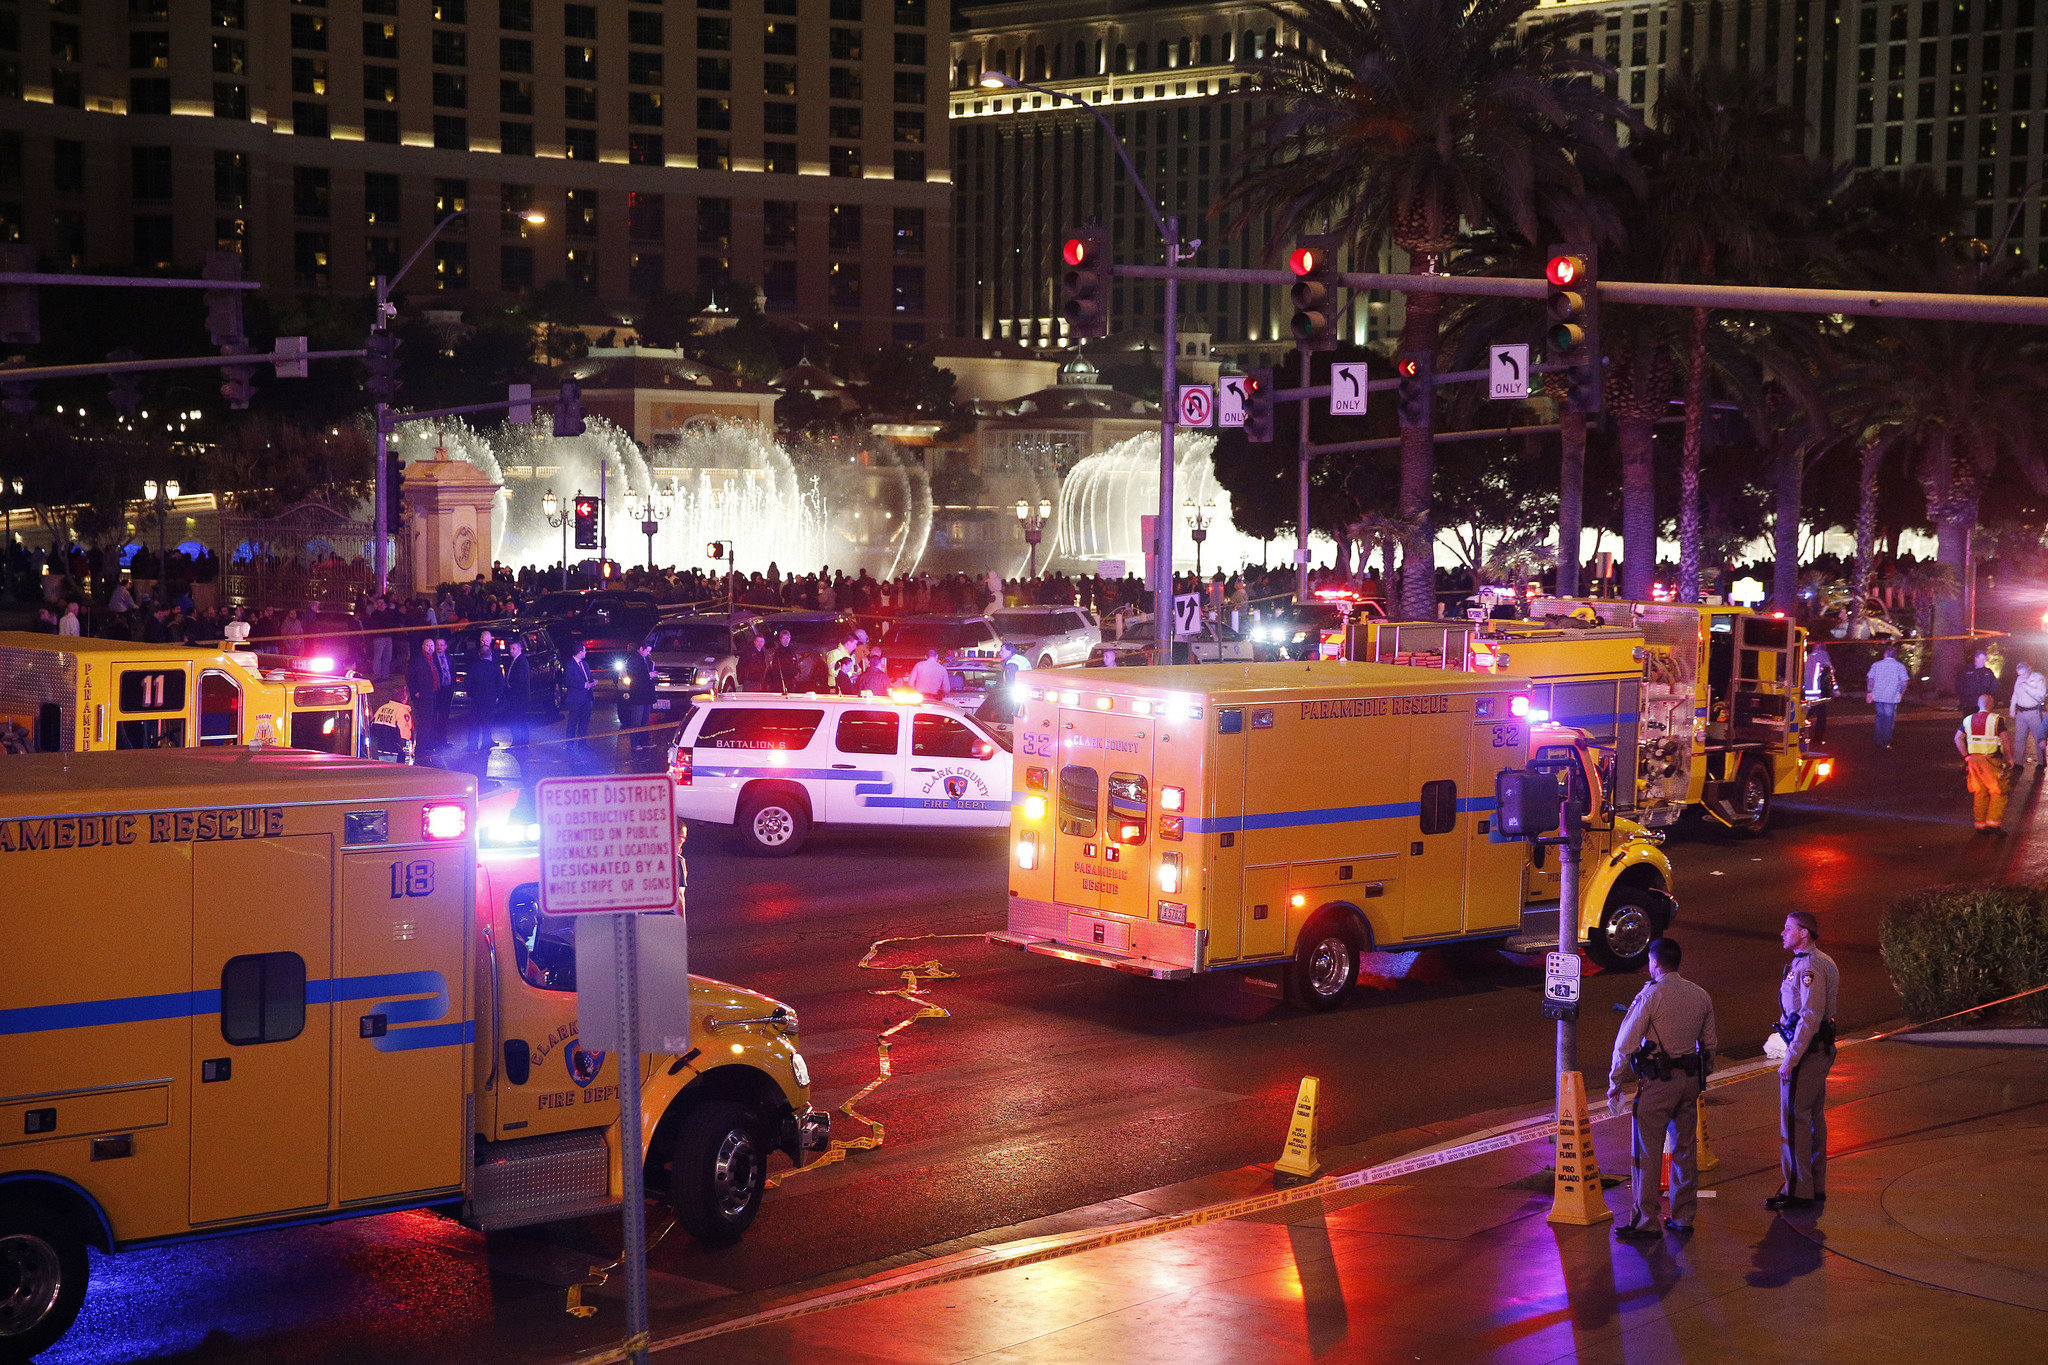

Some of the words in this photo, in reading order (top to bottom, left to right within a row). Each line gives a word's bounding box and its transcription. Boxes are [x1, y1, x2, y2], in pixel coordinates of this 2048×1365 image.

[1496, 384, 1522, 394] ONLY
[1335, 400, 1361, 410] ONLY
[142, 674, 165, 708] 11
[1300, 697, 1388, 720] PARAMEDIC
[1392, 695, 1449, 715] RESCUE
[376, 713, 394, 724] POLICE
[716, 740, 775, 749] BATTALION
[1023, 731, 1053, 757] 32
[1073, 734, 1103, 750] CLARK
[1105, 738, 1139, 754] COUNTY
[1492, 725, 1519, 747] 32
[922, 767, 954, 795] CLARK
[956, 766, 990, 798] COUNTY
[545, 788, 598, 806] RESORT
[923, 800, 949, 808] FIRE
[150, 807, 284, 843] RESCUE
[547, 812, 561, 825] NO
[565, 809, 635, 825] OBSTRUCTIVE
[640, 808, 667, 821] USES
[557, 828, 604, 842] PERMITTED
[609, 828, 622, 841] ON
[626, 825, 659, 840] PUBLIC
[547, 845, 599, 860] SIDEWALKS
[604, 845, 614, 857] AT
[620, 842, 669, 857] LOCATIONS
[551, 861, 630, 877] DESIGNATED
[636, 859, 653, 873] BY
[658, 860, 665, 871] A
[1074, 861, 1129, 880] PARAMEDIC
[390, 860, 435, 899] 18
[549, 881, 578, 896] WHITE
[581, 879, 613, 894] STRIPE
[621, 879, 635, 892] OR
[642, 877, 671, 891] SIGNS
[1082, 878, 1119, 895] RESCUE
[538, 1090, 575, 1110] FIRE
[1582, 1150, 1594, 1158] FLOOR
